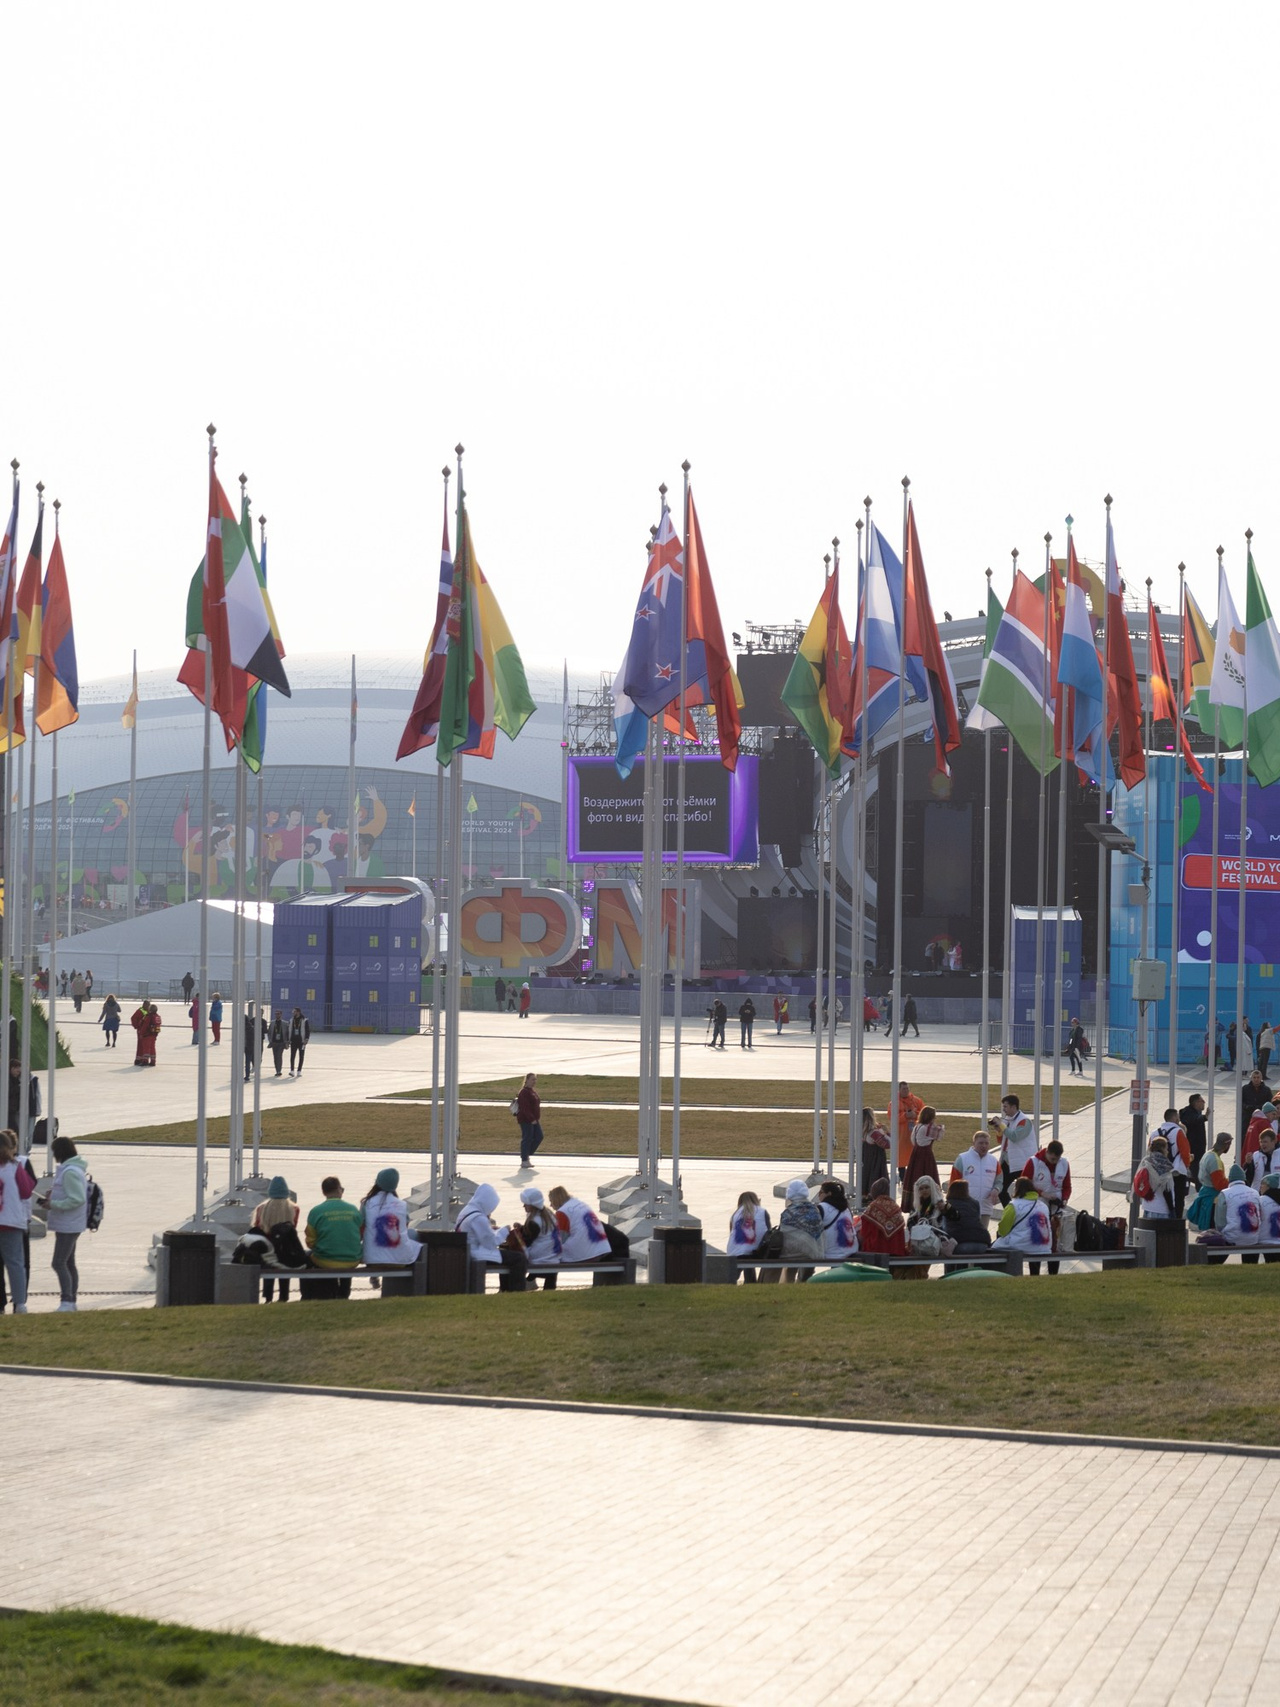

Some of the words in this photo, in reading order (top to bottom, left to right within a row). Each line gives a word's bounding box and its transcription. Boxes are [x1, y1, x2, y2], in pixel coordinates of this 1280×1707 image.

[662, 798, 674, 807] от
[587, 812, 613, 825] фото
[616, 814, 622, 822] и
[1221, 860, 1266, 872] WORLD
